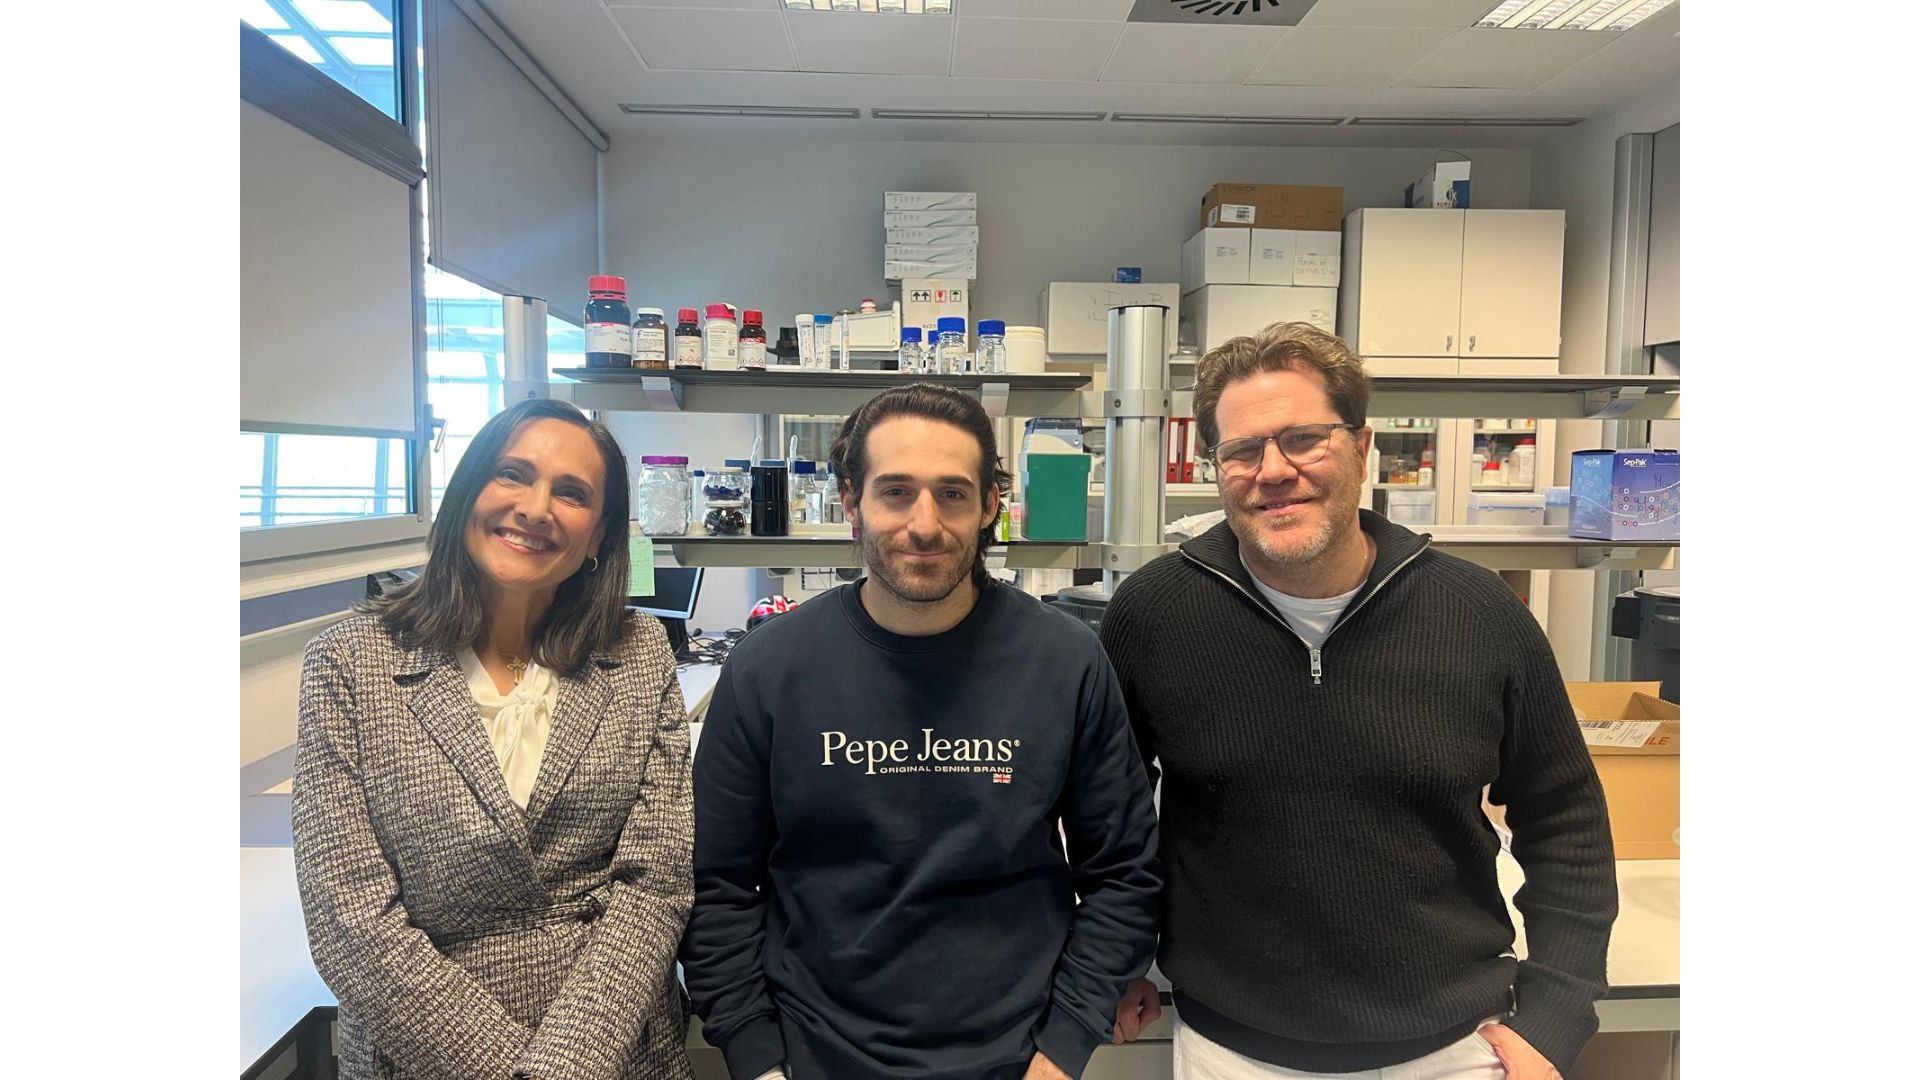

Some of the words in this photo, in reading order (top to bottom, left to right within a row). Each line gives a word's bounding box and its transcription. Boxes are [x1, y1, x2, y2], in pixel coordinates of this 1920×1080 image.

[820, 731, 909, 775] Pepe
[879, 765, 932, 774] ORIGINAL
[934, 765, 970, 773] DENIM
[973, 766, 1013, 774] BRAND
